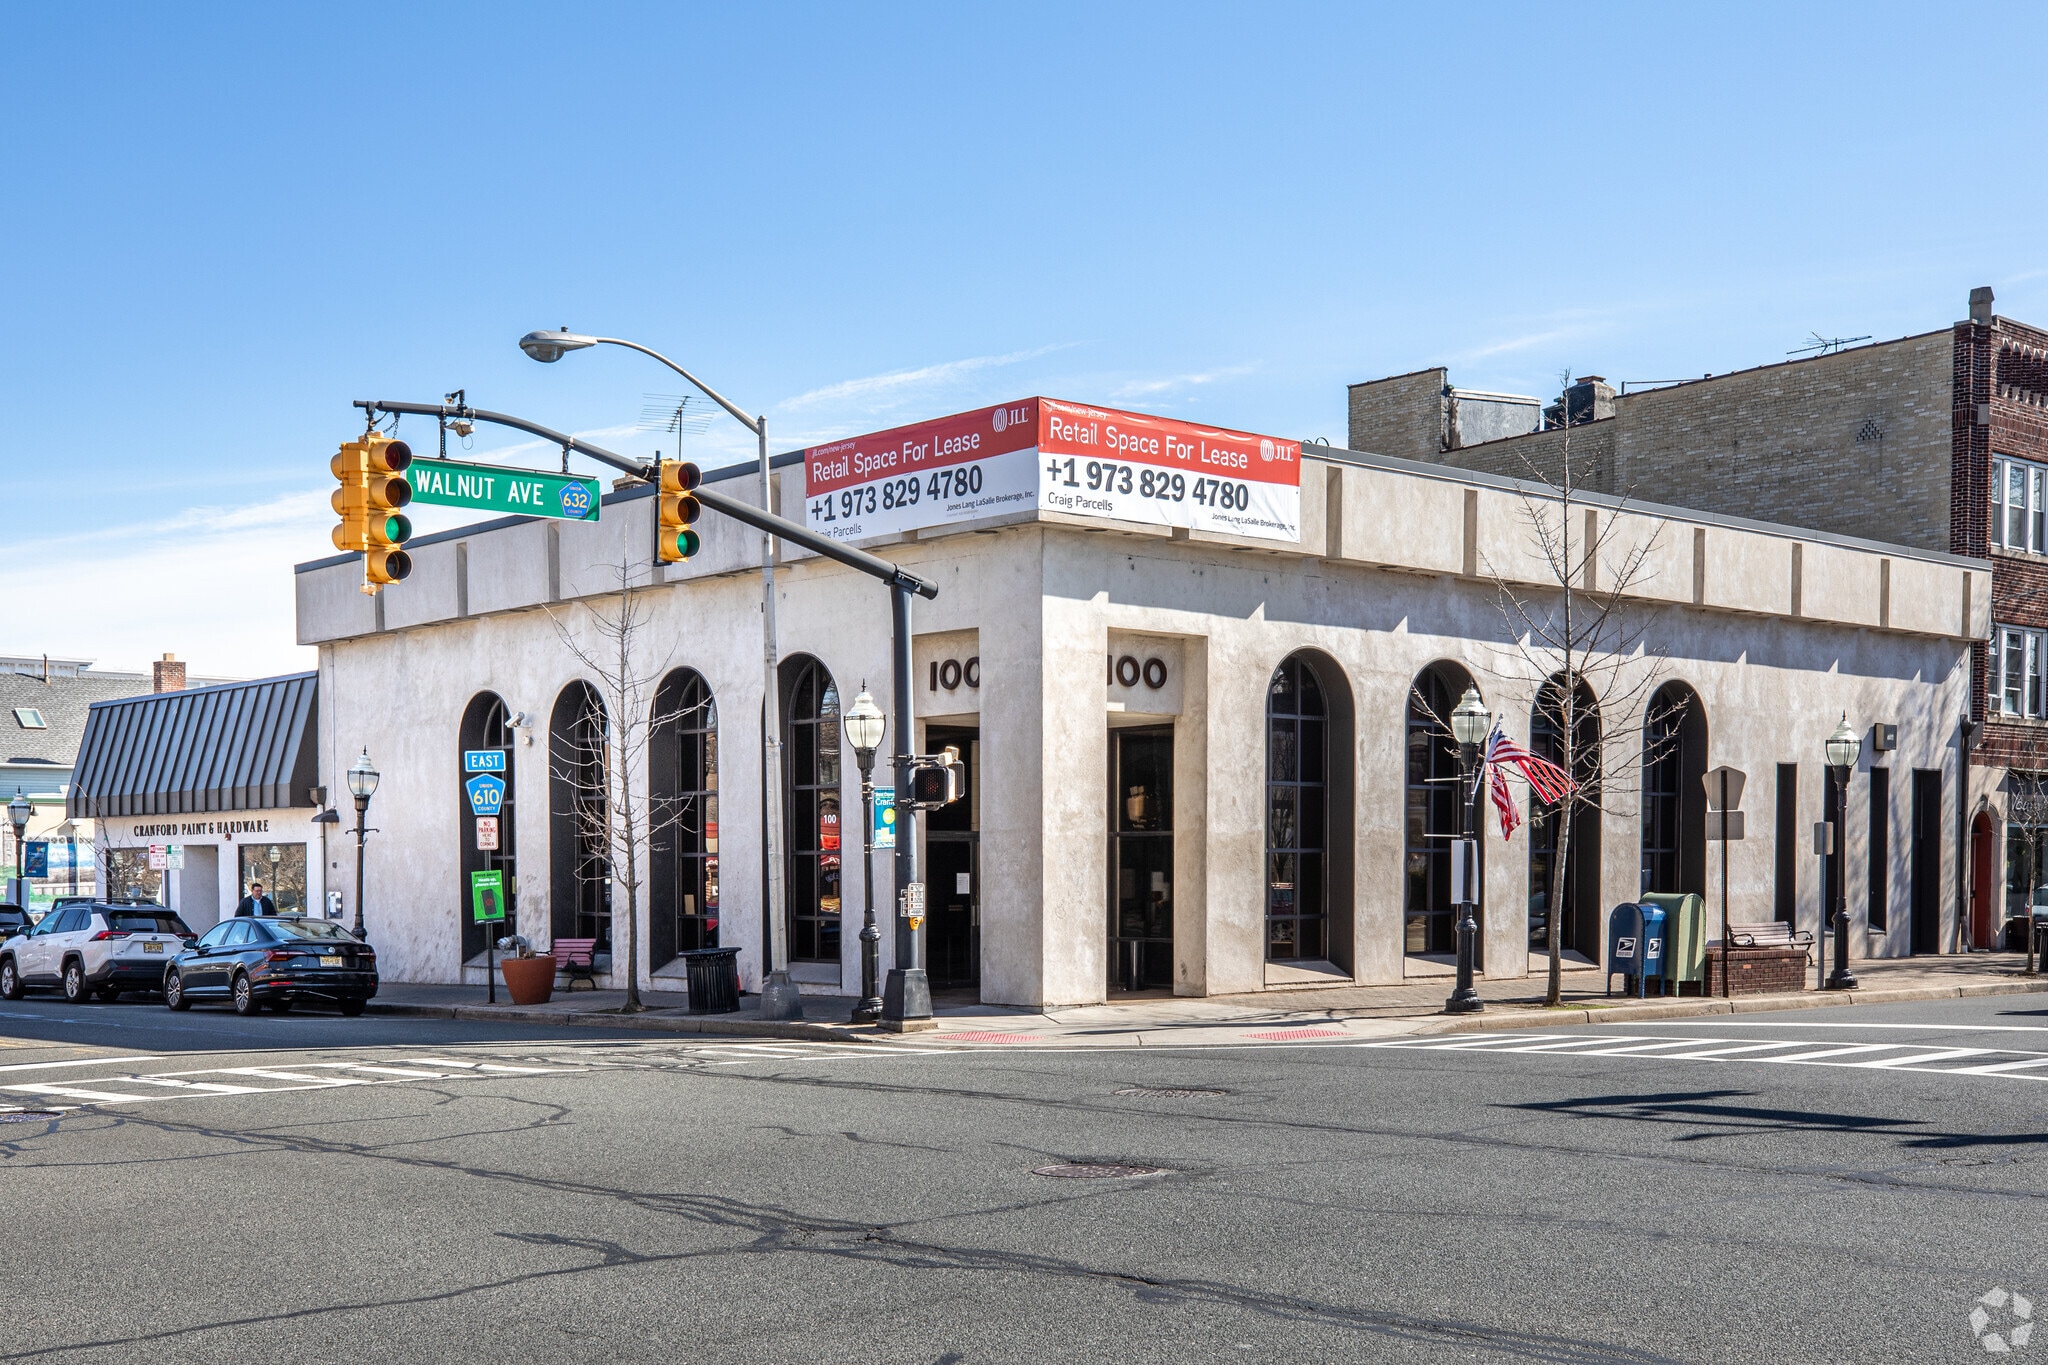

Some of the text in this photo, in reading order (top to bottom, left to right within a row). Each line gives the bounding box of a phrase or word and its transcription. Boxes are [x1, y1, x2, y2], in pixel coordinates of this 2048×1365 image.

[1008, 408, 1028, 426] JLL
[1050, 416, 1248, 469] Retail Space For Lease
[812, 432, 980, 483] Retail Space For Lease
[1275, 445, 1293, 461] JLL
[416, 470, 544, 506] WALNUT AVE
[812, 464, 983, 522] +1 973 829 4780
[1047, 458, 1249, 512] +1 973 829 4780
[564, 492, 587, 508] 632
[946, 503, 961, 511] Jones
[962, 501, 975, 509] Lang
[976, 497, 995, 506] LaSalle
[996, 493, 1024, 503] Brokerage,
[1048, 492, 1112, 511] Craig Parcells
[1241, 517, 1259, 526] LaSalle
[834, 523, 862, 538] Parcells
[471, 755, 499, 767] EAST
[473, 789, 499, 805] 610
[824, 815, 836, 824] 100
[134, 820, 268, 837] CRANFORD PAINT & HARDWARE
